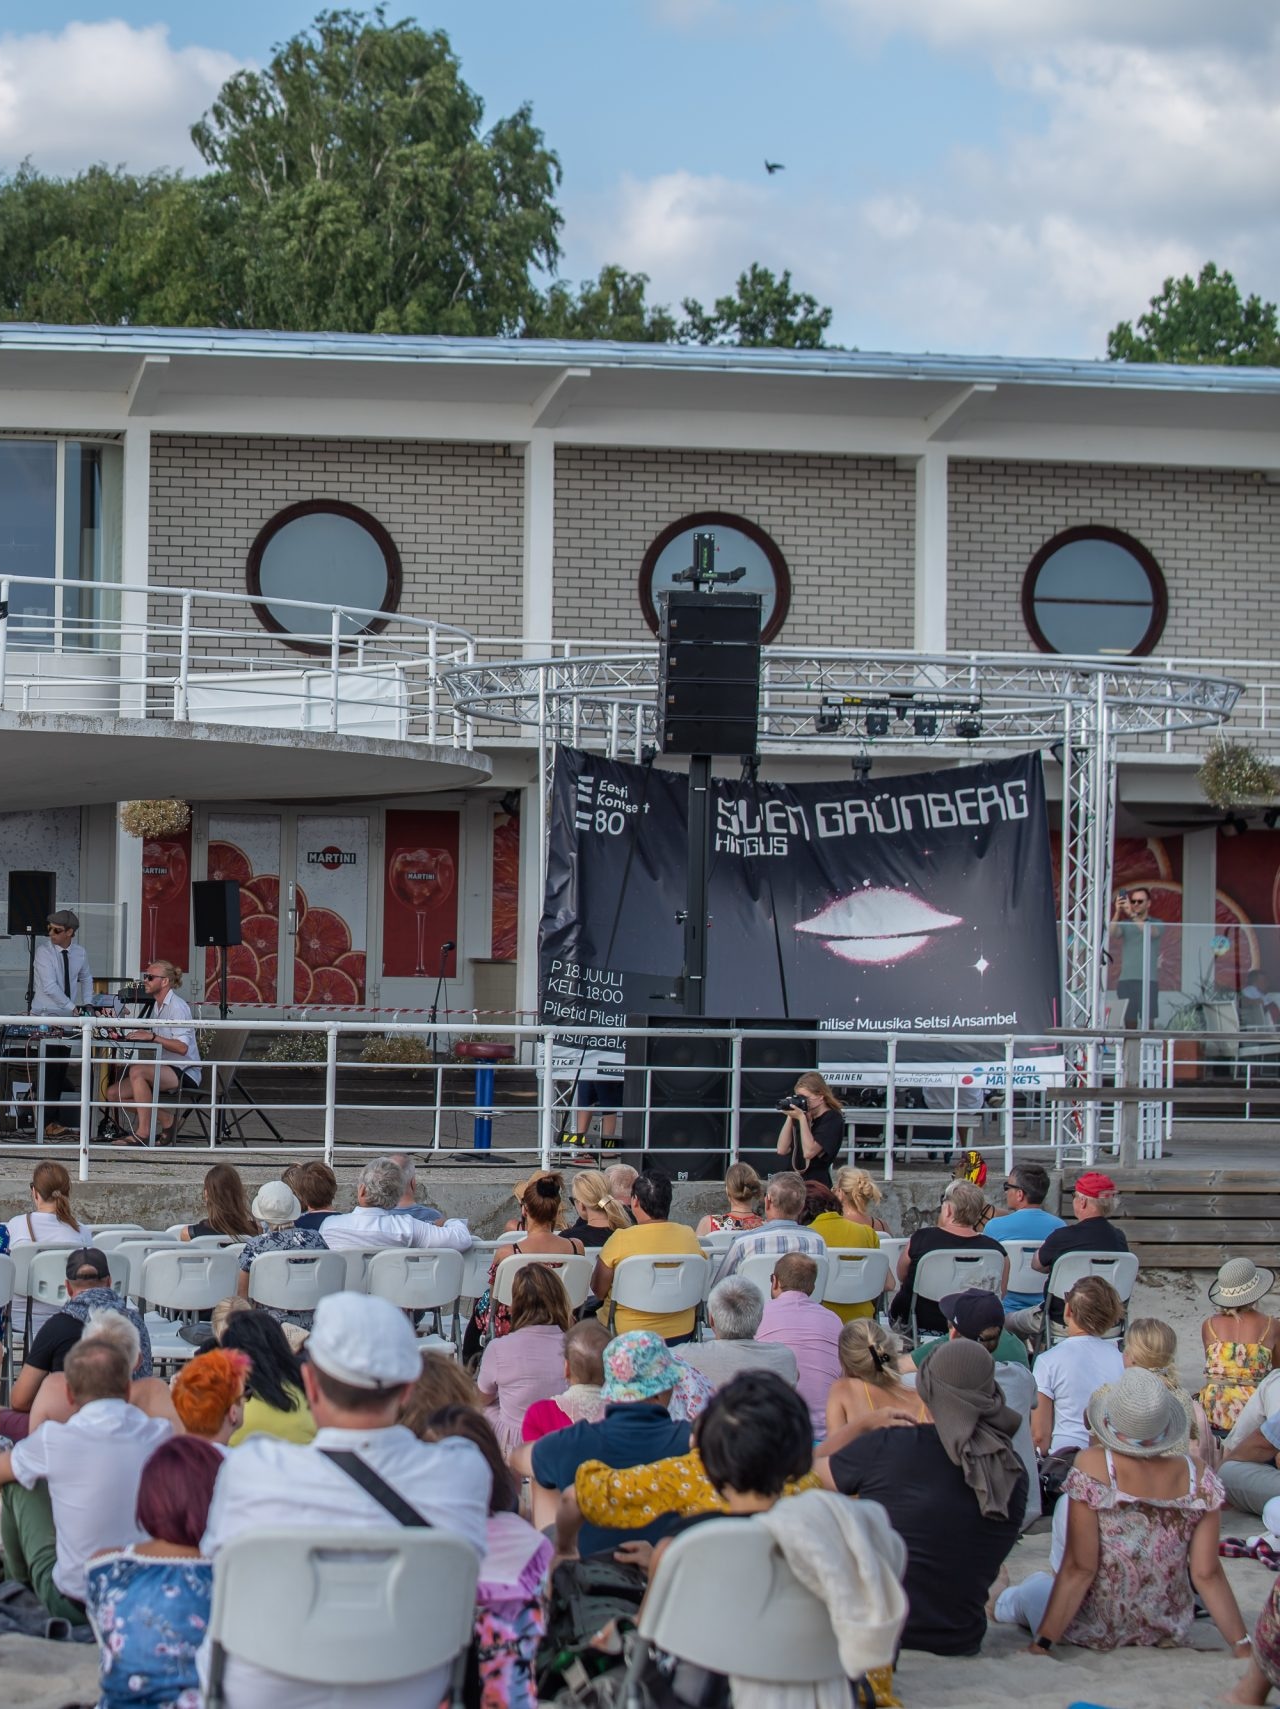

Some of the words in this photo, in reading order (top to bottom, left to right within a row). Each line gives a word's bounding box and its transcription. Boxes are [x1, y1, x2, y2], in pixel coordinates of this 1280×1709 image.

[599, 780, 628, 798] Eesti
[596, 793, 651, 814] Kontset
[816, 779, 1029, 838] GRÜNBERG
[595, 809, 625, 835] 80
[715, 833, 788, 856] HINGUS
[309, 853, 355, 864] MARTINI
[551, 960, 562, 974] P
[564, 962, 582, 979] 18.
[583, 968, 623, 987] JUULI
[548, 977, 584, 998] KELL
[586, 986, 624, 1004] 18:00
[543, 1000, 587, 1021] Piletid
[857, 1018, 911, 1030] Muusika
[914, 1015, 949, 1028] Seltsi
[952, 1012, 1018, 1027] Ansambel
[986, 1075, 1040, 1085] MAKETS
